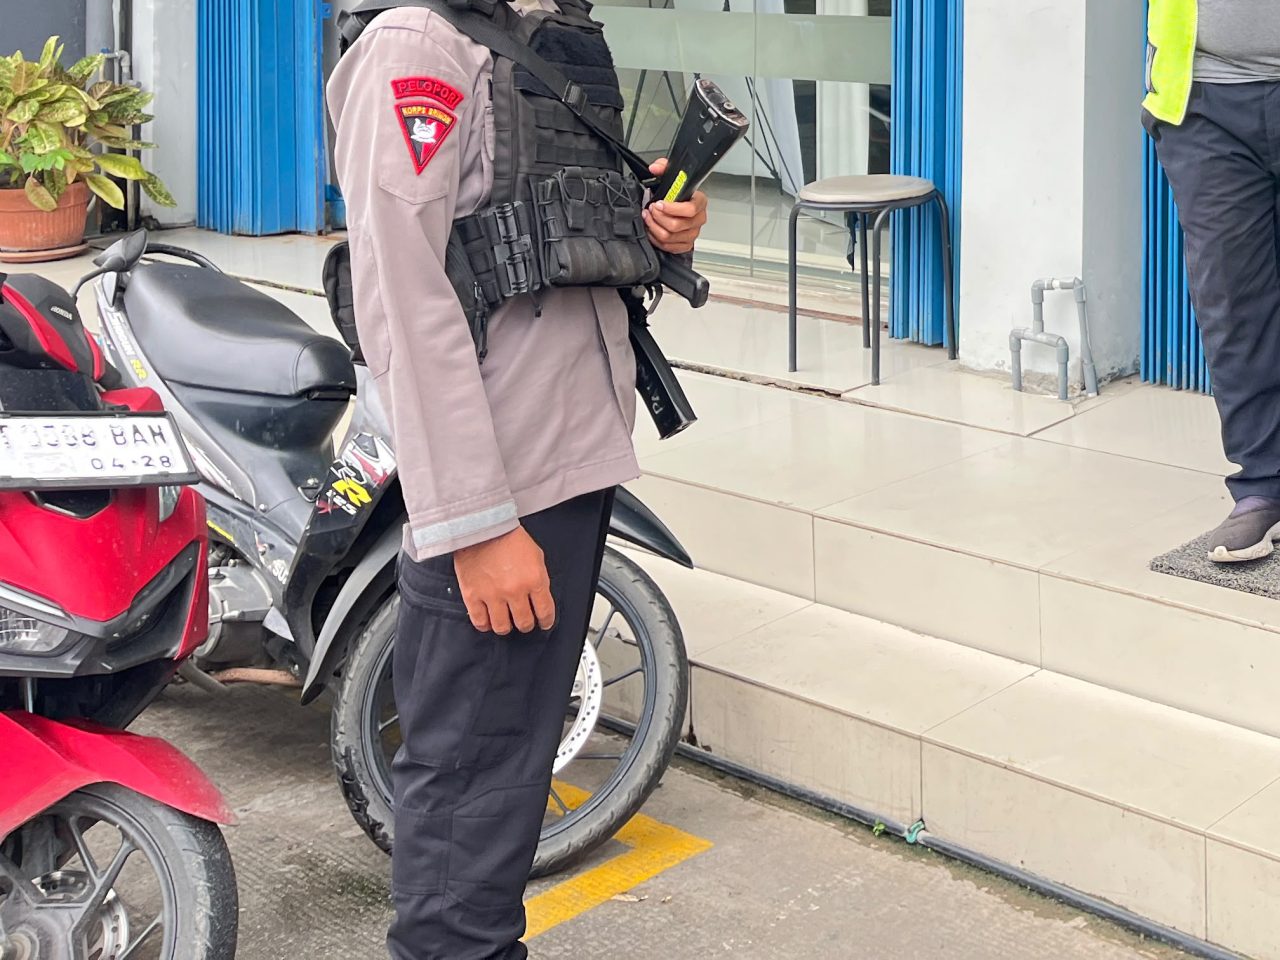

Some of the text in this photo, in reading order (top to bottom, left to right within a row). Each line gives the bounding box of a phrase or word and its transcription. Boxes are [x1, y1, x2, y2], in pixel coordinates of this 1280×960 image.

[397, 80, 456, 105] PELOPOR
[402, 106, 453, 125] KORPS BRIMOB
[109, 424, 166, 446] BAH
